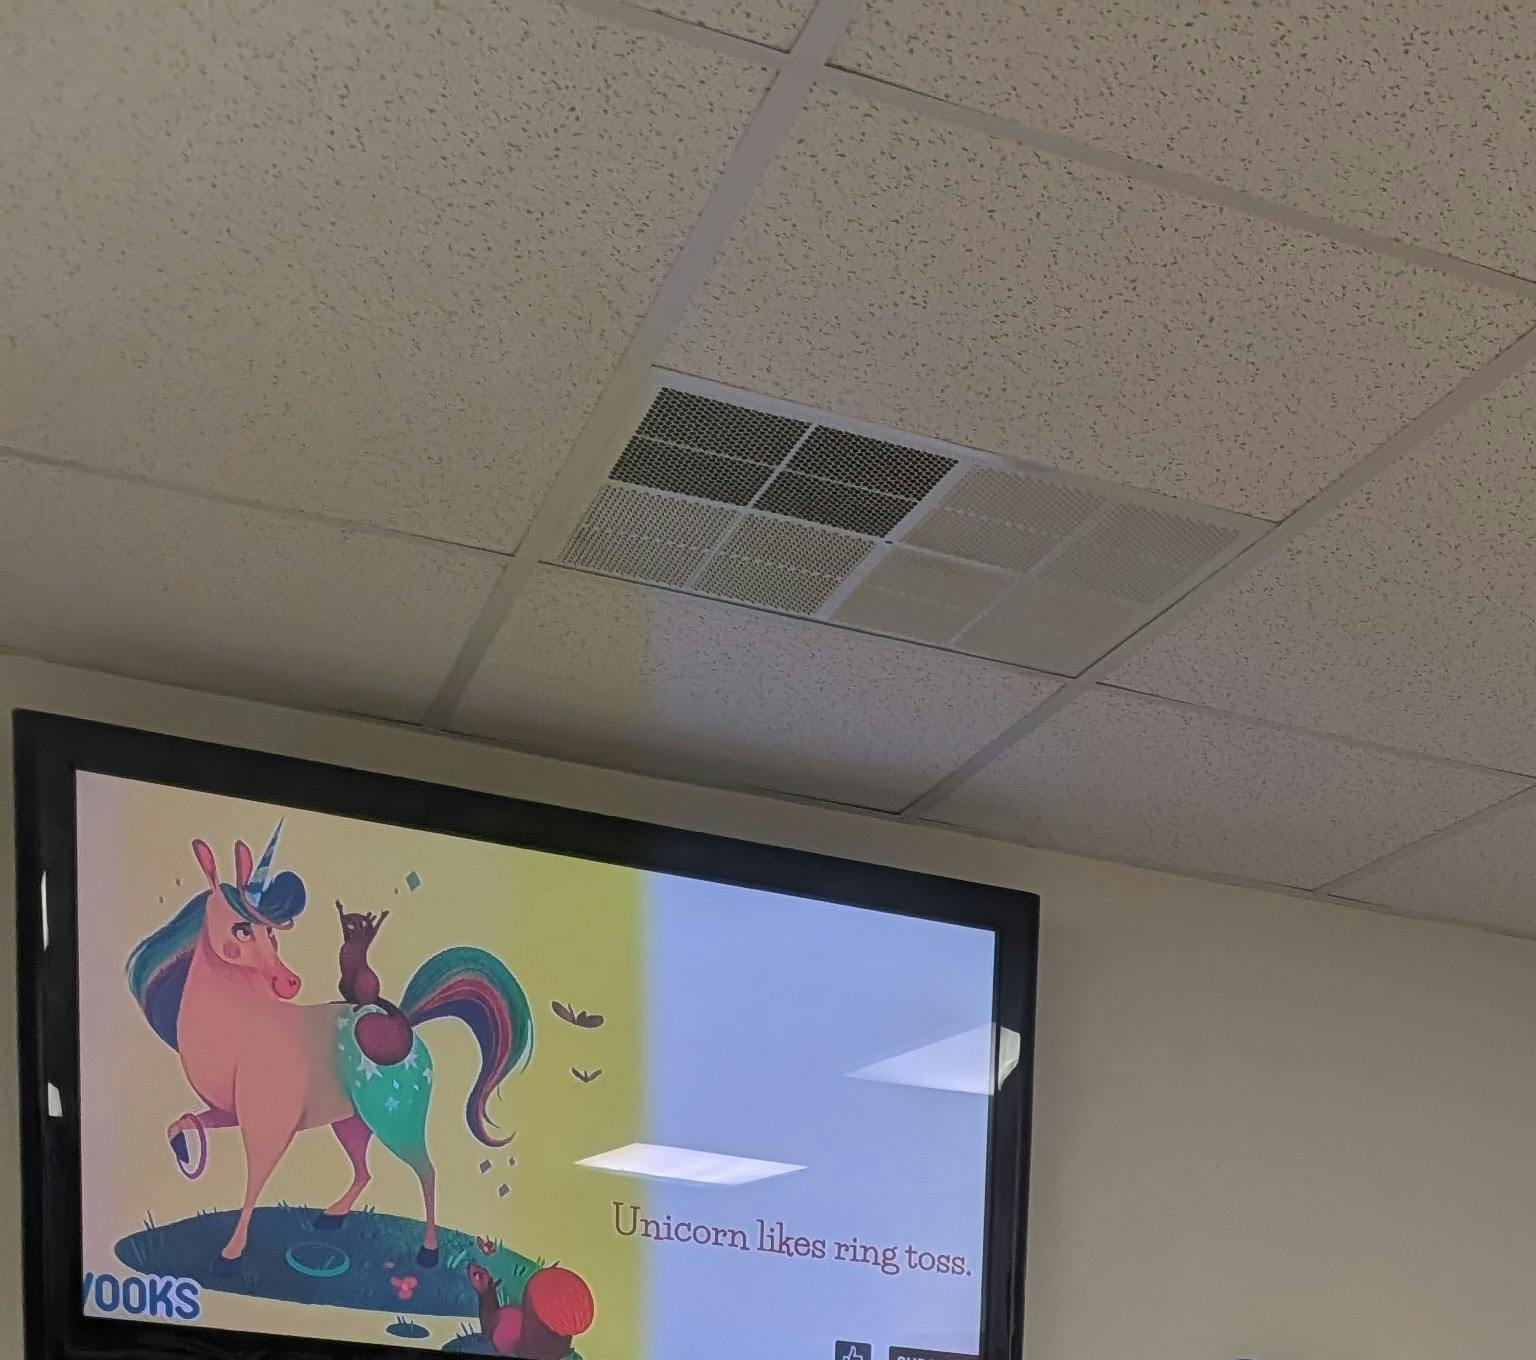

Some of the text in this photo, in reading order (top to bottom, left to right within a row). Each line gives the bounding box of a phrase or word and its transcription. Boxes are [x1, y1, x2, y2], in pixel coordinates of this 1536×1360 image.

[612, 1201, 972, 1277] Unicorn likes ring toss.
